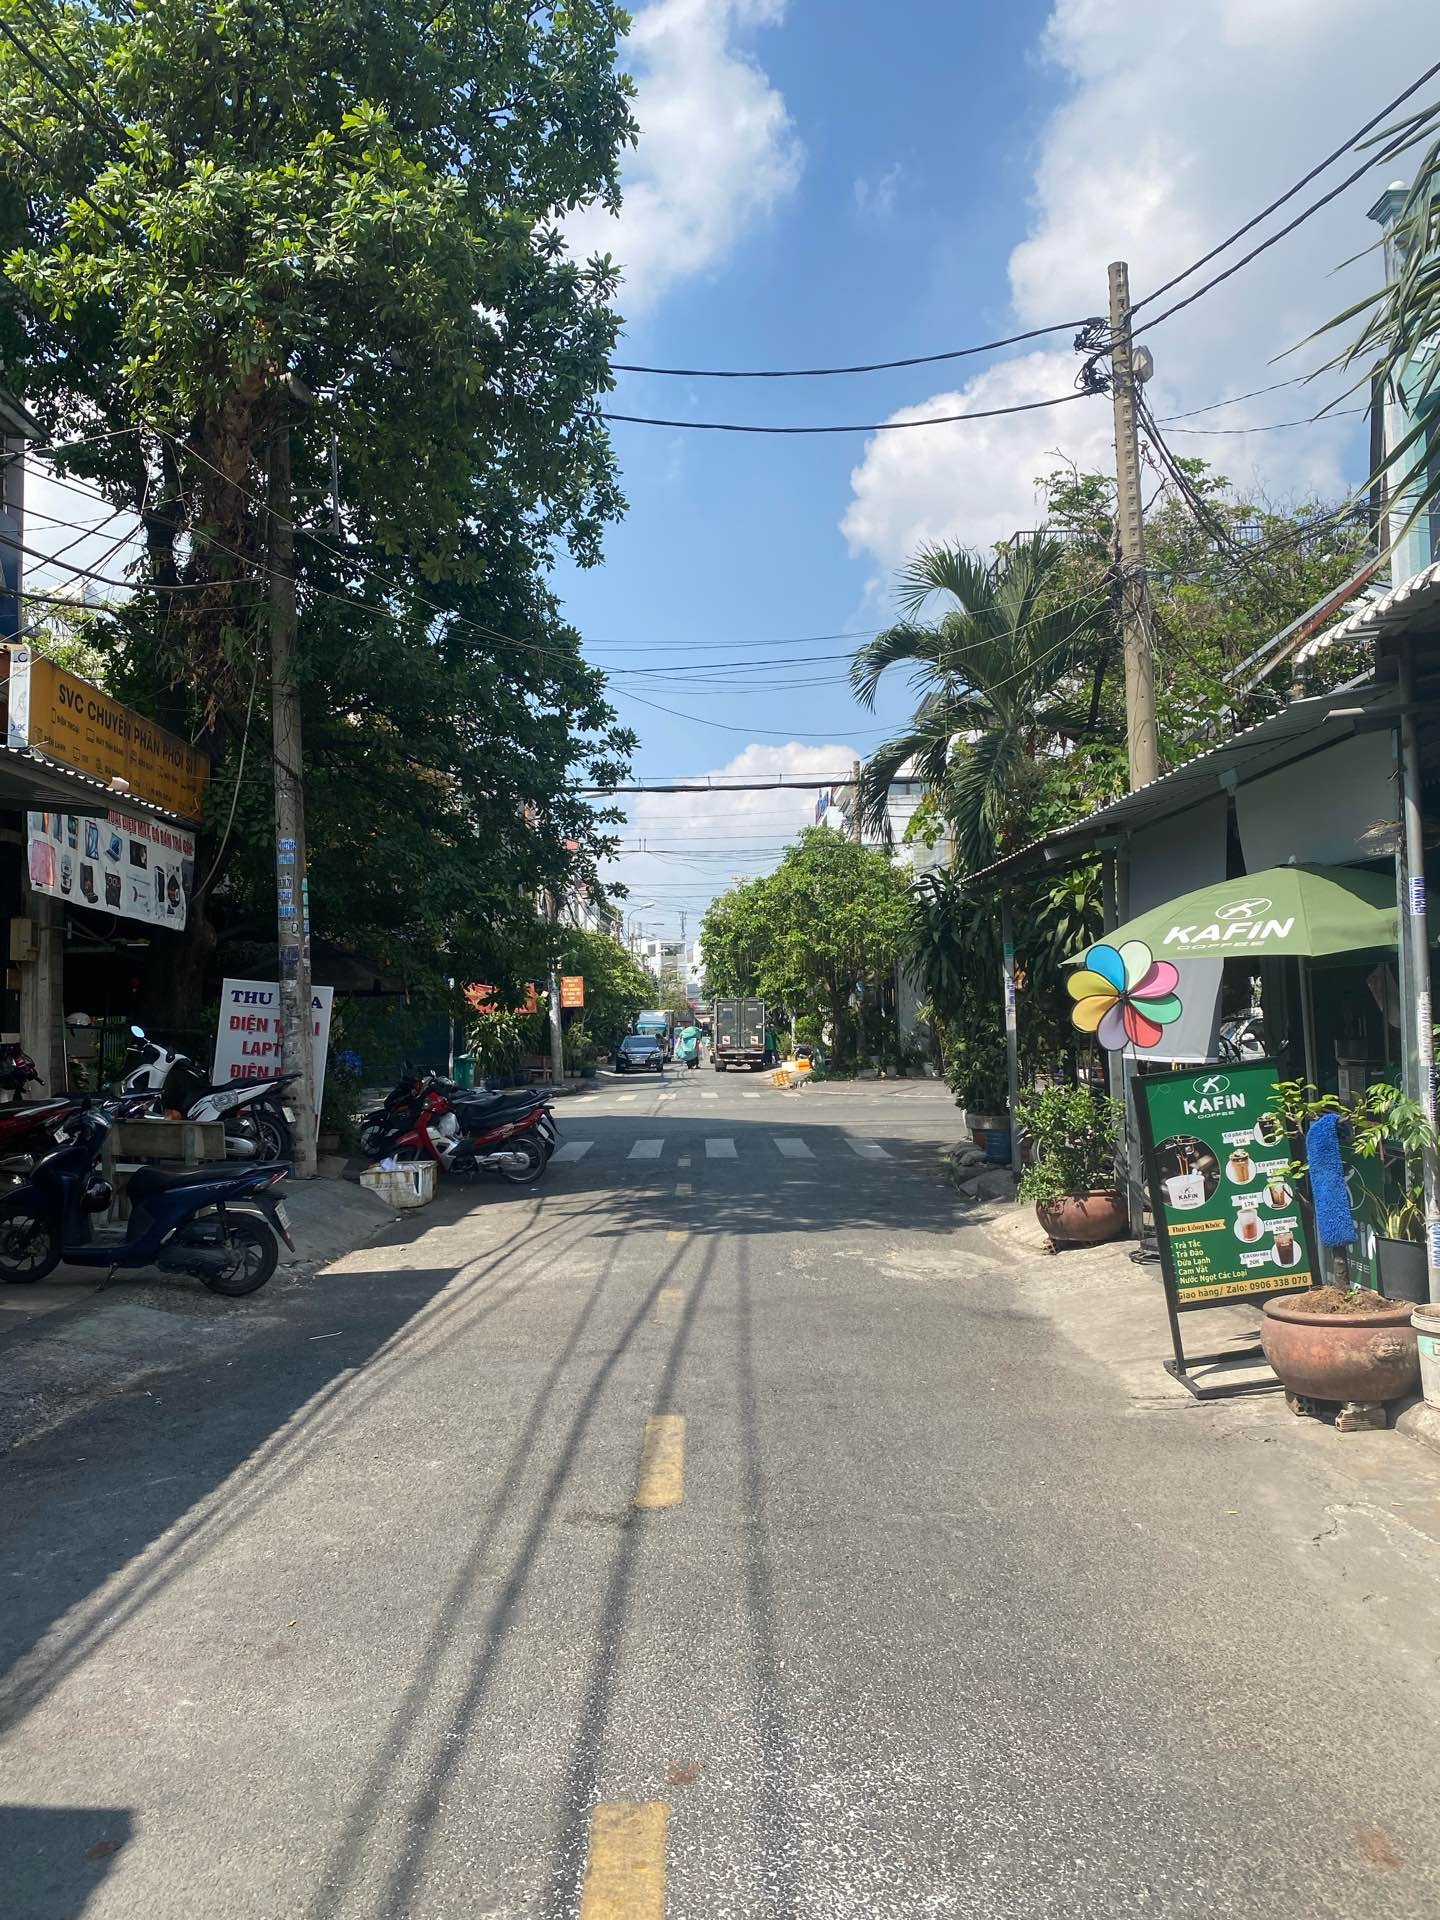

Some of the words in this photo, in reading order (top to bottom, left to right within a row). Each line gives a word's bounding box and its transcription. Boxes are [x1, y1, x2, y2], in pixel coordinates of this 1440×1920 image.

[59, 684, 84, 714] SVC
[88, 701, 132, 741] CHUYÊN
[134, 726, 160, 757] PHÂN
[1177, 940, 1265, 950] COFFEE
[231, 990, 273, 1005] THU
[229, 1014, 268, 1034] ĐIỆN
[242, 1041, 284, 1057] LAPT
[1197, 1111, 1236, 1120] COFFEE
[1174, 1241, 1187, 1249] Trà
[1175, 1250, 1188, 1258] Trà
[1178, 1268, 1194, 1276] Cam
[1218, 1271, 1231, 1280] Các
[1226, 1285, 1248, 1294] Zalo:
[1249, 1281, 1272, 1290] 0906
[1273, 1278, 1290, 1288] 338
[1292, 1275, 1308, 1285] 070
